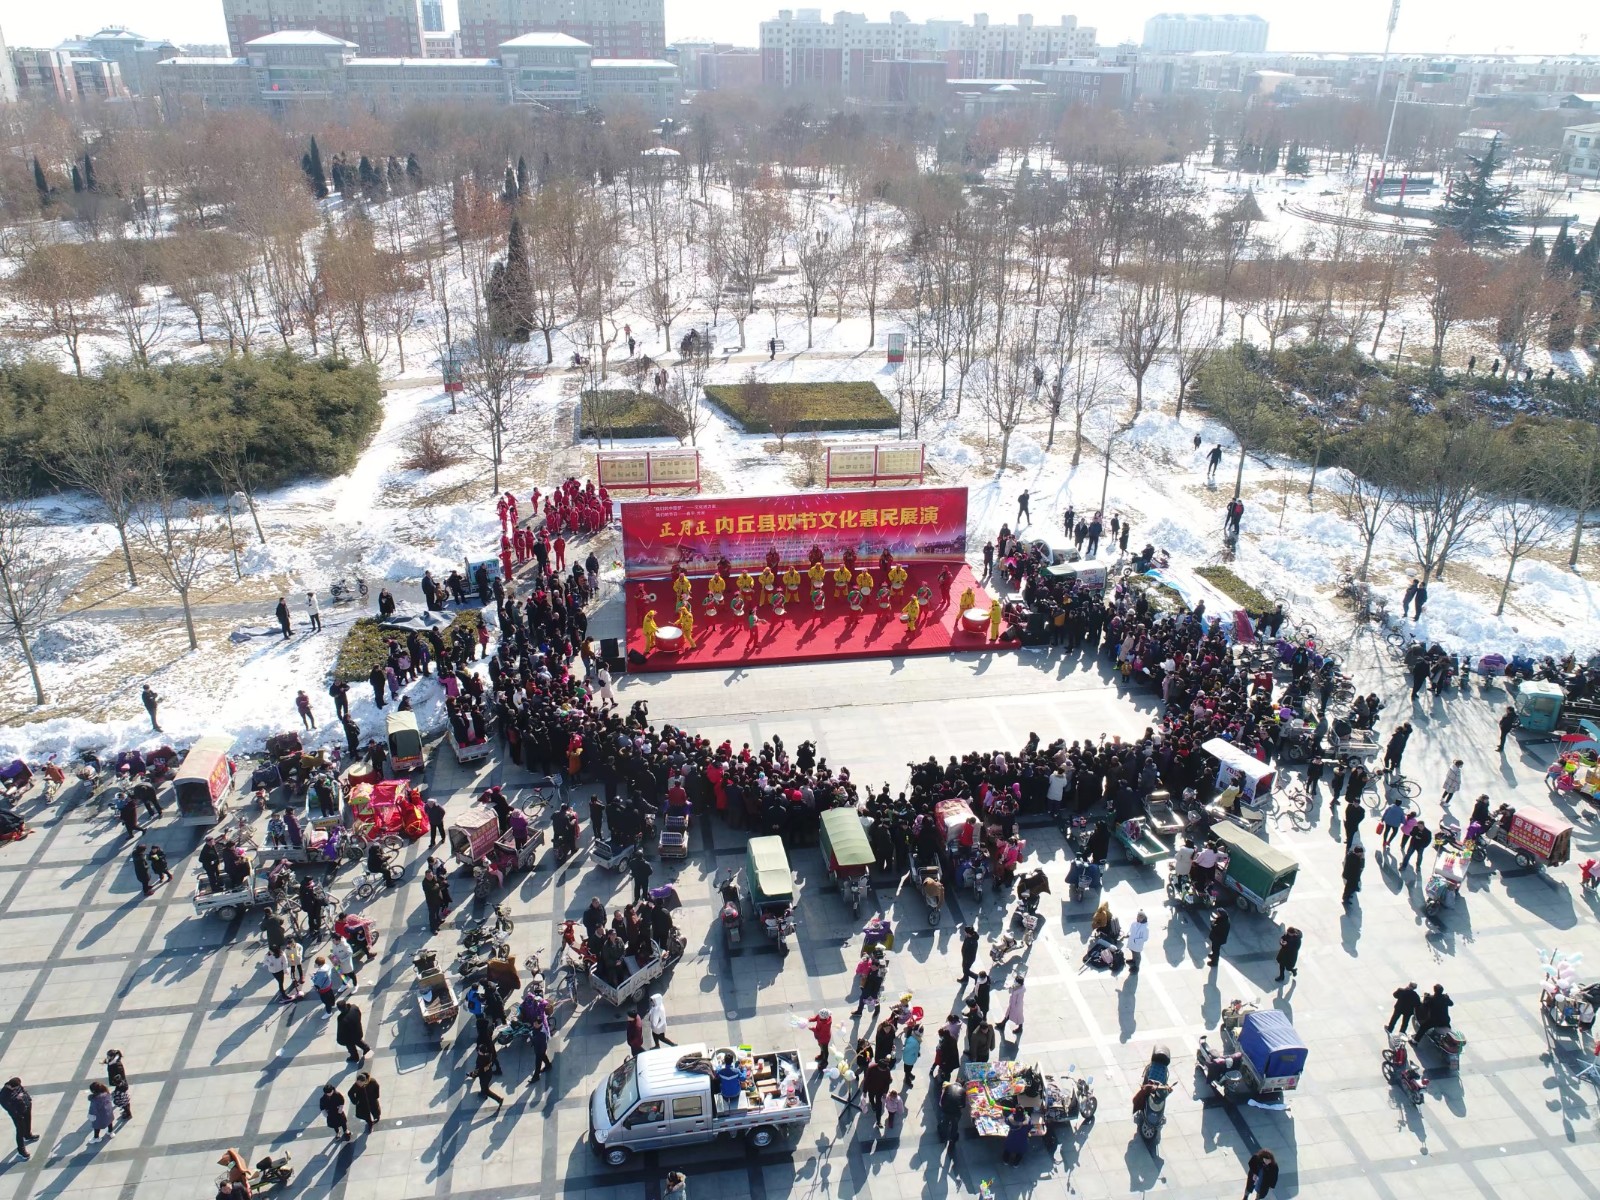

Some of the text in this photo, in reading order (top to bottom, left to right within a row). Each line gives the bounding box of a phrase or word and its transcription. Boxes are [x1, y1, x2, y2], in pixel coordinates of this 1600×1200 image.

[659, 506, 939, 538] 正月正 内丘县双节文化惠民展演
